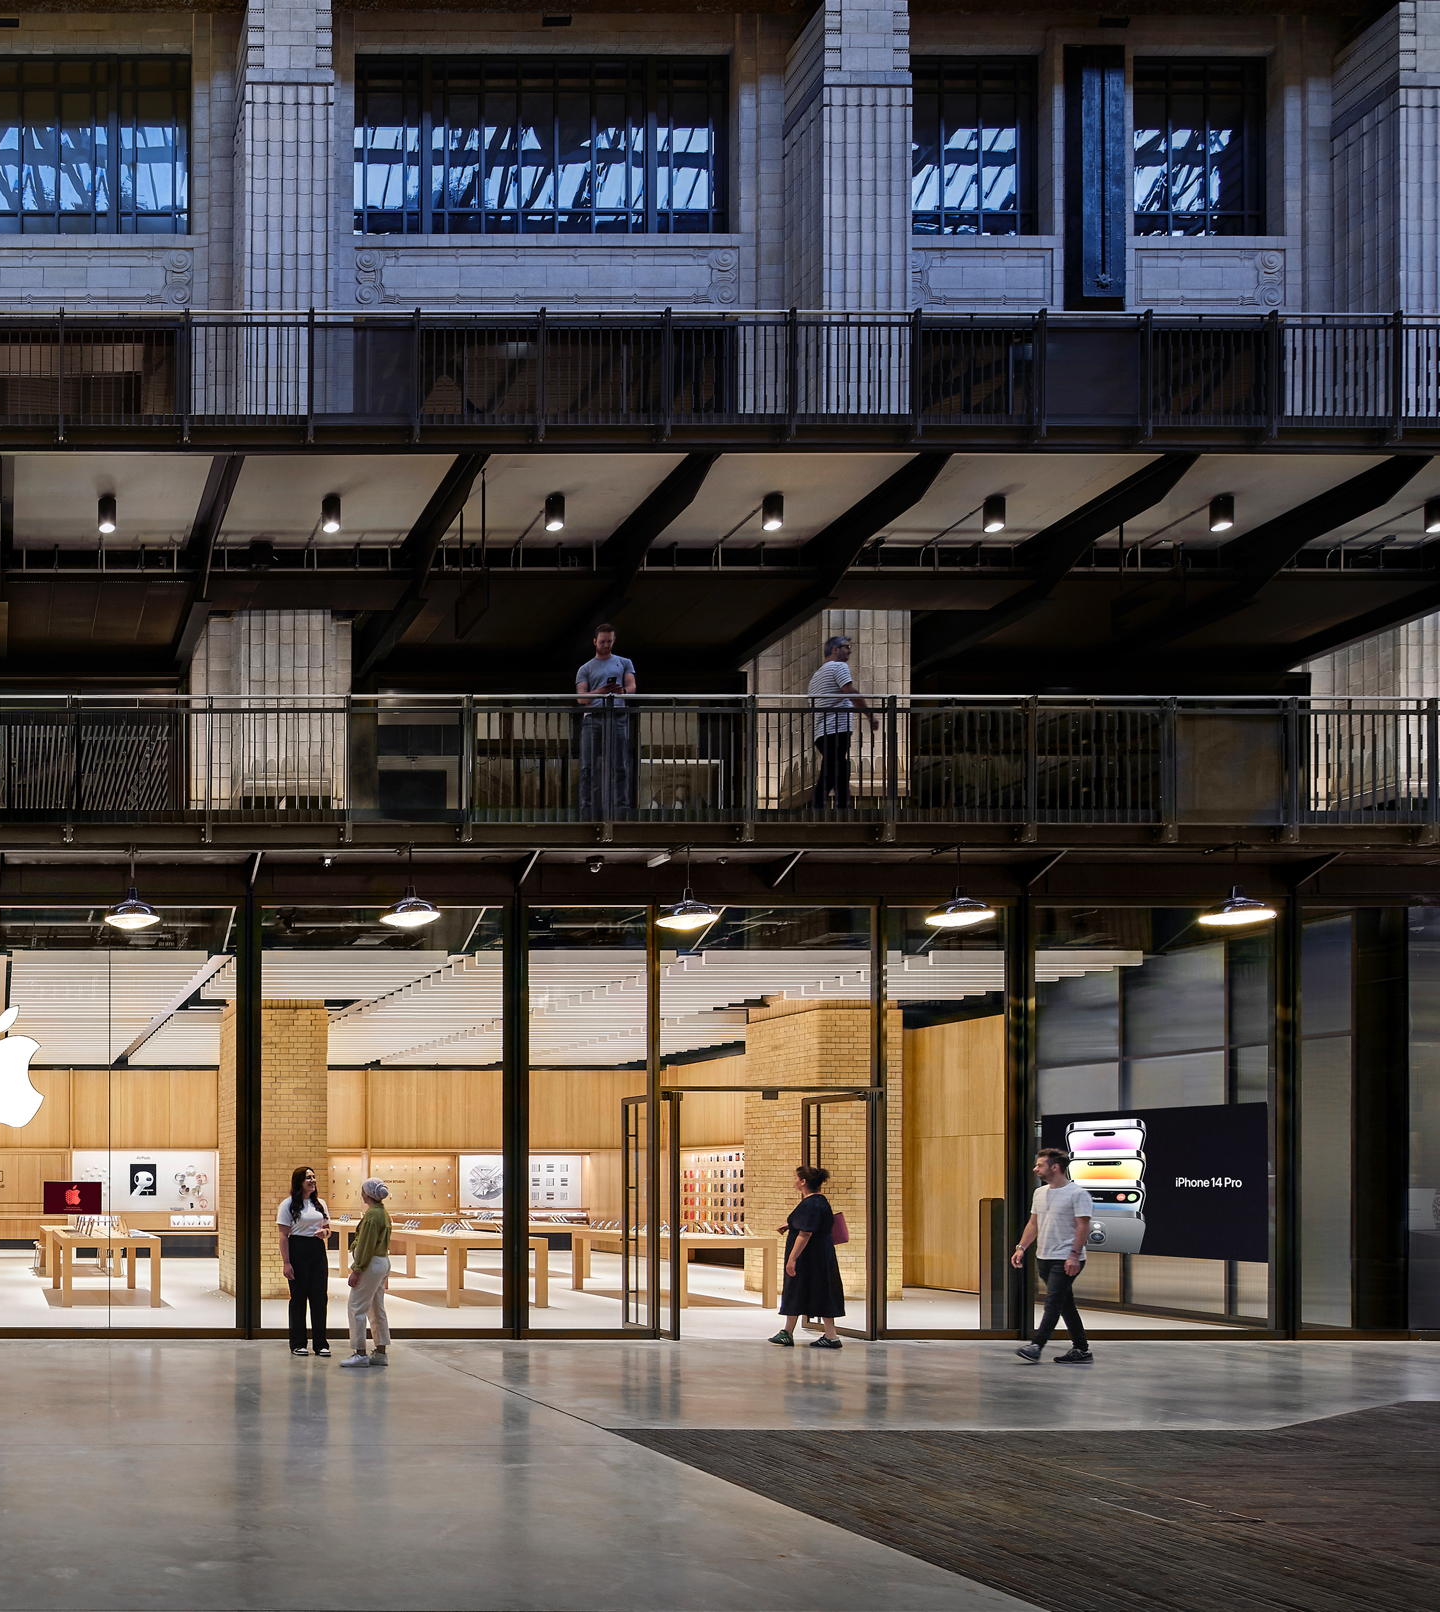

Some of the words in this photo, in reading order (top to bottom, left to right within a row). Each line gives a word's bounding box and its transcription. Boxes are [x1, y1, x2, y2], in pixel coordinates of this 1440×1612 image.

[1175, 1177, 1210, 1188] iPhone
[1210, 1177, 1223, 1188] 14
[1224, 1177, 1243, 1188] Pro
